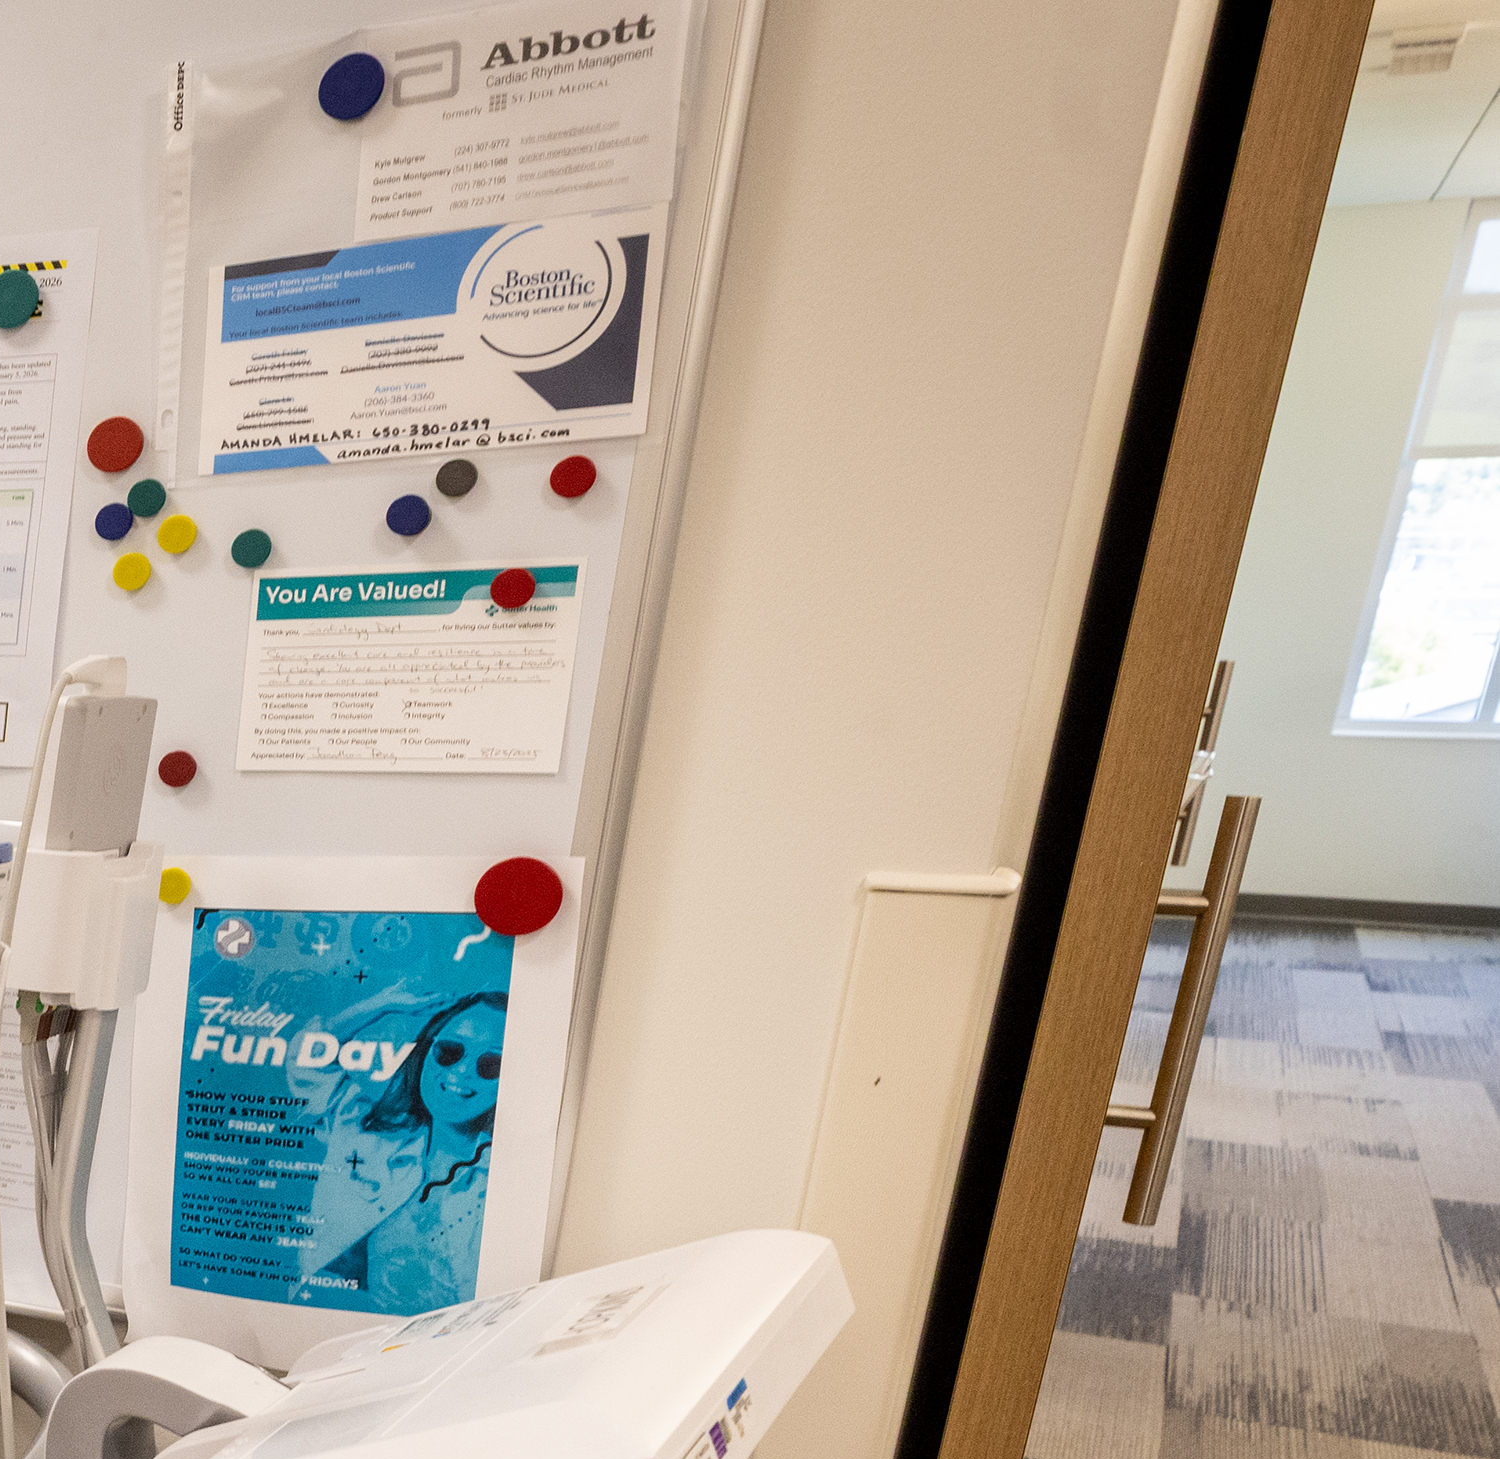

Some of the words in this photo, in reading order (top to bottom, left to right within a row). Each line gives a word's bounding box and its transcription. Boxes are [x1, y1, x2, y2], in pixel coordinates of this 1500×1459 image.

[480, 13, 656, 71] Abbott
[486, 70, 528, 88] Cardiac
[531, 62, 575, 80] Rhythm
[578, 46, 653, 70] Management
[559, 78, 610, 97] MEDICAL
[174, 91, 185, 131] Office
[442, 106, 483, 123] formerly
[375, 160, 391, 169] Kyle
[393, 155, 426, 165] Mulgrew
[373, 176, 400, 186] Gordon
[403, 168, 451, 180] Montgomery
[371, 195, 390, 204] Drew
[392, 190, 422, 200] Carlson
[370, 211, 400, 222] Product
[402, 205, 433, 217] Support
[39, 277, 62, 289] 2026
[231, 285, 245, 293] For
[246, 281, 278, 292] support
[280, 278, 300, 287] from
[302, 276, 320, 286] your
[322, 272, 342, 282] local
[344, 268, 374, 278] Boston
[376, 261, 416, 273] Scientific
[506, 269, 570, 289] Boston
[489, 273, 595, 307] Scientific
[482, 309, 529, 322] Advancing
[533, 304, 564, 315] science
[568, 302, 580, 310] for
[220, 436, 282, 450] AMANDA
[289, 428, 361, 445] HMELAR:
[266, 585, 306, 605] You
[312, 583, 352, 602] Are
[358, 579, 446, 601] Valued!
[530, 604, 557, 612] Health
[340, 701, 374, 709] Curiosity
[412, 712, 445, 720] Integrity
[198, 995, 294, 1038] Friday
[190, 1025, 287, 1067] Fun
[296, 1032, 416, 1082] Day
[188, 1089, 226, 1101] SHOW
[230, 1093, 266, 1104] YOUR
[269, 1097, 310, 1107] STUFF
[187, 1103, 225, 1115] STRUT
[228, 1107, 237, 1115] &
[241, 1108, 287, 1120] STRIDE
[186, 1116, 225, 1129] EVERY
[228, 1120, 275, 1133] FRIDAY
[280, 1124, 315, 1136] WITH
[185, 1130, 210, 1141] ONE
[214, 1133, 261, 1146] SUTTER
[264, 1137, 305, 1149] PRIDE
[184, 1161, 212, 1172] SHOW
[216, 1165, 240, 1175] WHO
[243, 1168, 277, 1178] YOU'RE
[281, 1171, 318, 1181] REPPIN
[180, 1224, 210, 1236] CAN'T
[214, 1230, 246, 1241] WEAR
[250, 1234, 274, 1244] ANY
[181, 1213, 200, 1222] THE
[203, 1216, 231, 1227] ONLY
[234, 1219, 272, 1231] CATCH
[290, 1226, 314, 1236] YOU
[178, 1259, 201, 1269] LET'S
[203, 1263, 227, 1274] HAVE
[230, 1268, 256, 1277] SOME
[260, 1271, 280, 1280] FUN
[282, 1273, 297, 1282] ON
[301, 1275, 359, 1290] FRIDAYS
